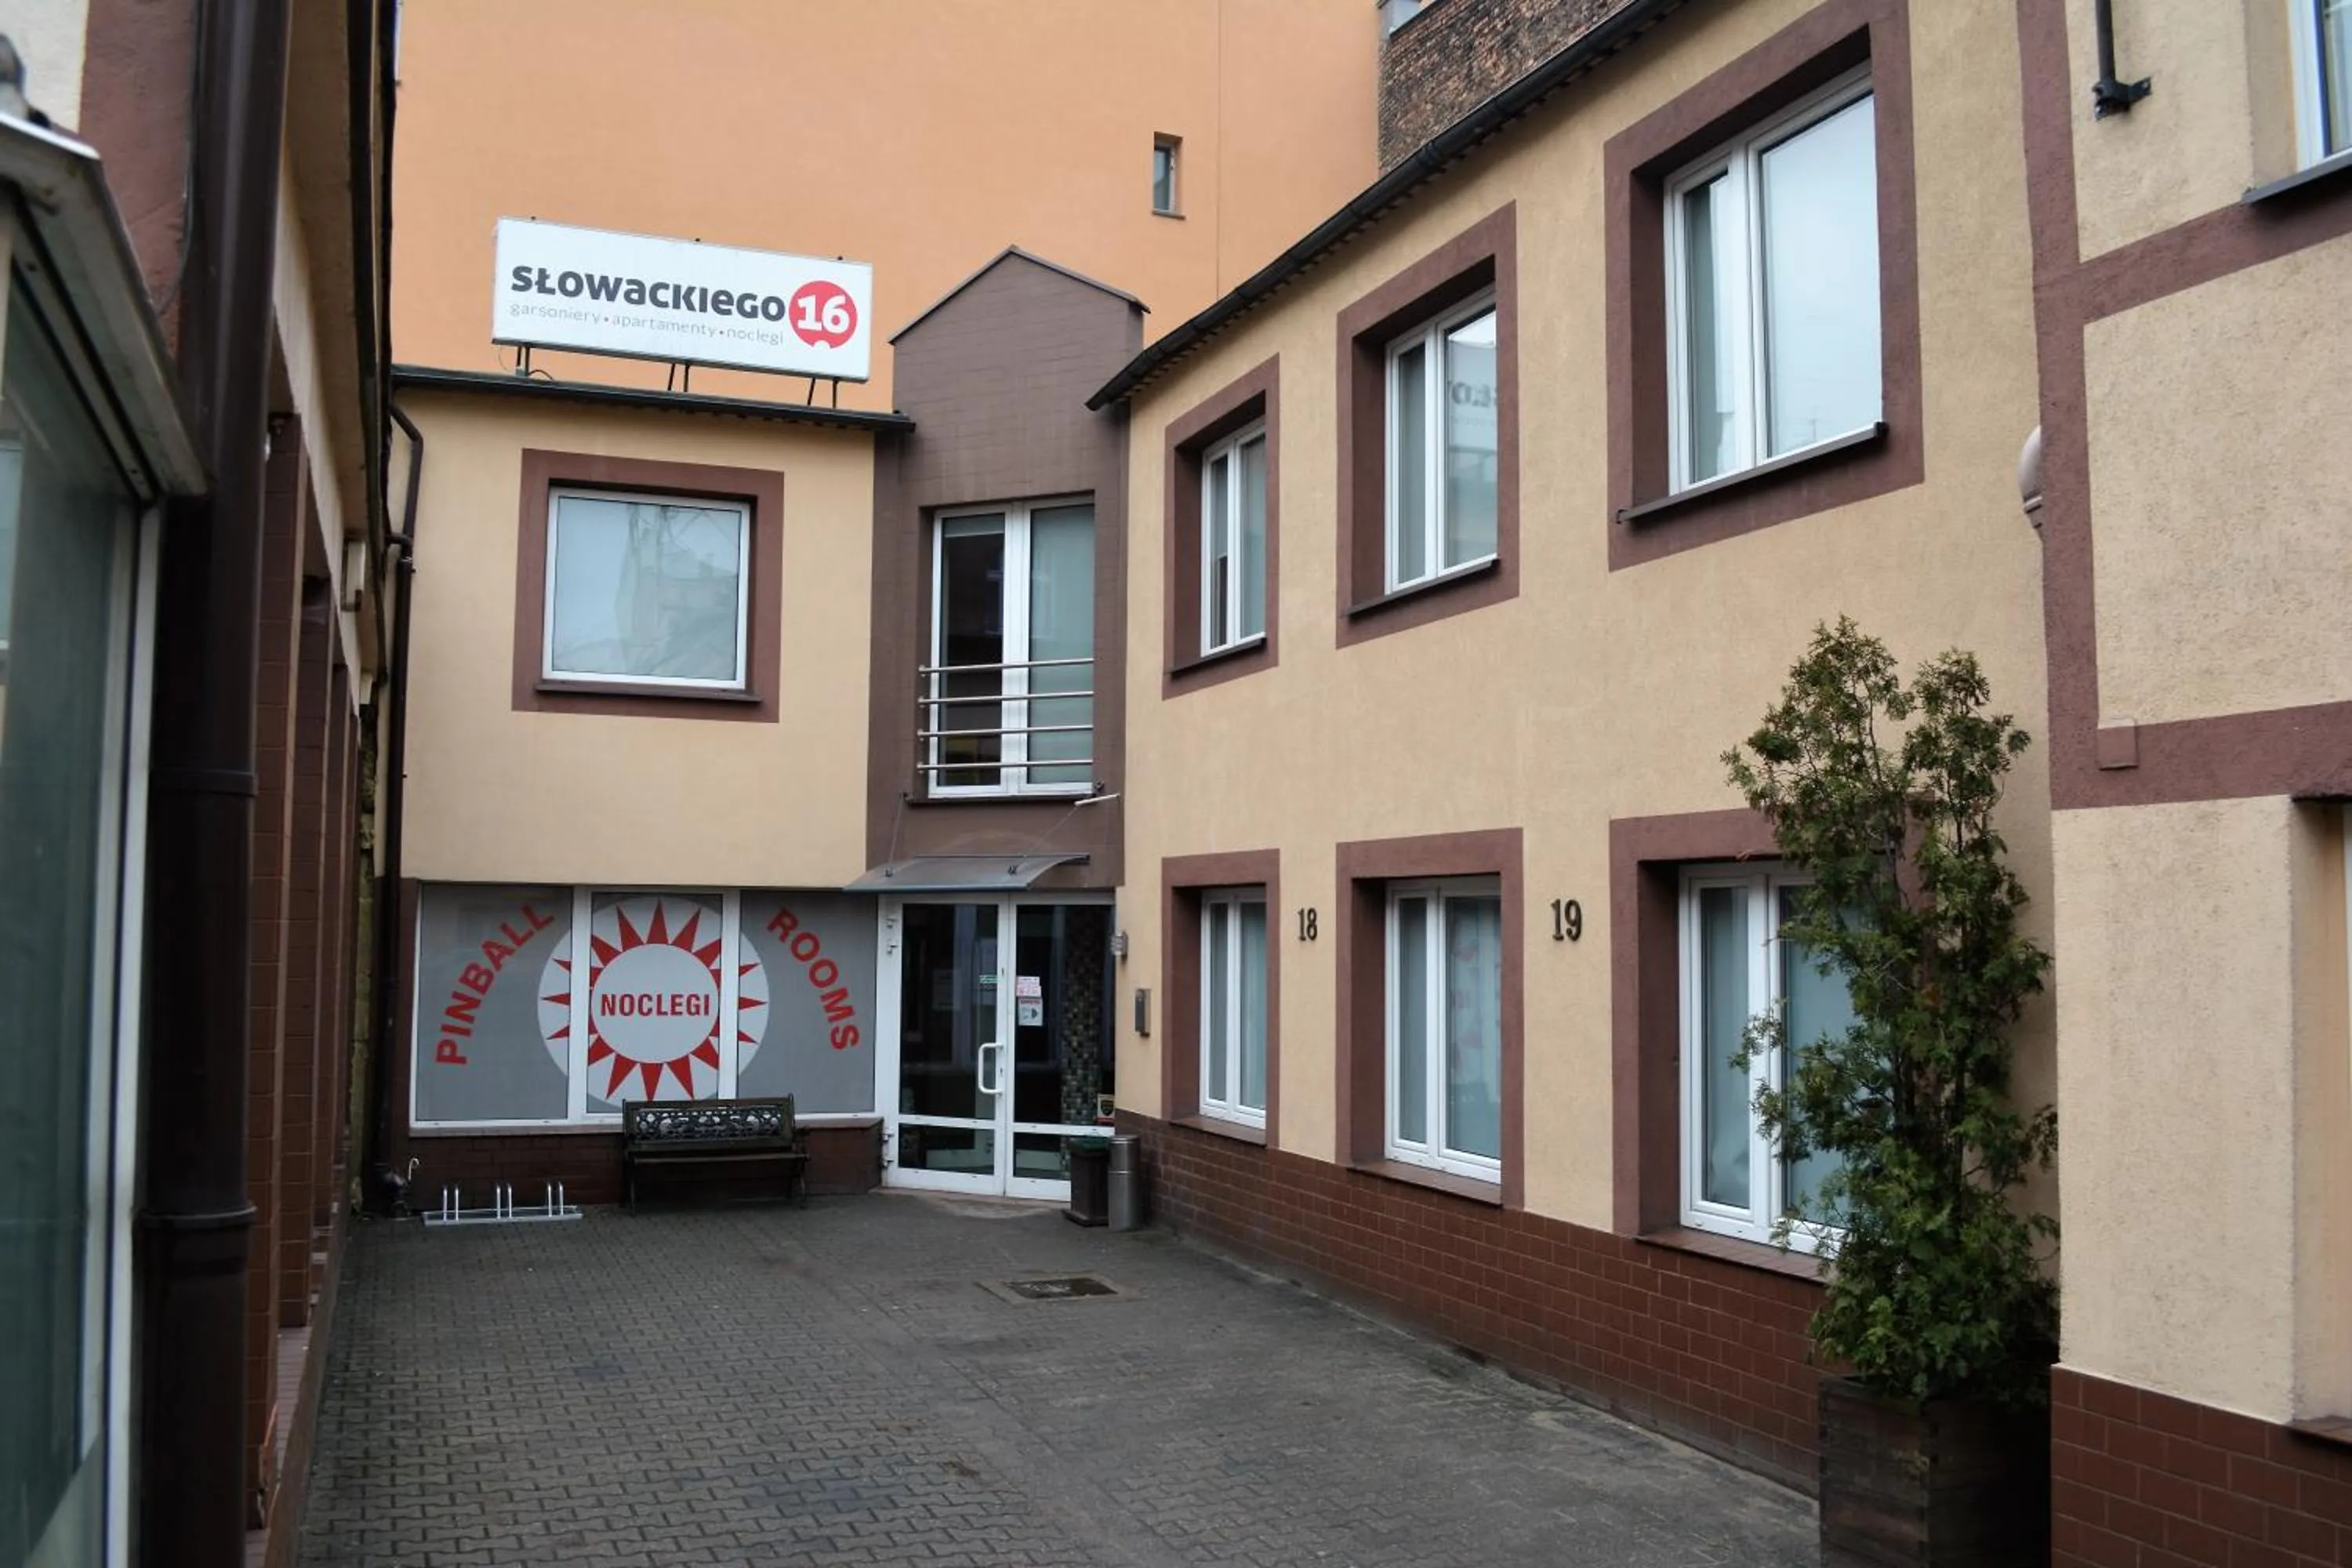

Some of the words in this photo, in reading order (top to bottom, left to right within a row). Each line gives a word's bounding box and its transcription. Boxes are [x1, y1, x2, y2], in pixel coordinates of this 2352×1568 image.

[510, 303, 600, 324] garsoniery
[612, 315, 717, 337] apartamenty
[726, 326, 784, 346] noclegi
[797, 295, 850, 334] 16
[1298, 908, 1318, 941] 18
[1551, 898, 1582, 940] 19
[436, 903, 554, 1065] PINBALL
[767, 908, 860, 1051] ROOMS
[601, 993, 710, 1017] NOCLEGI
